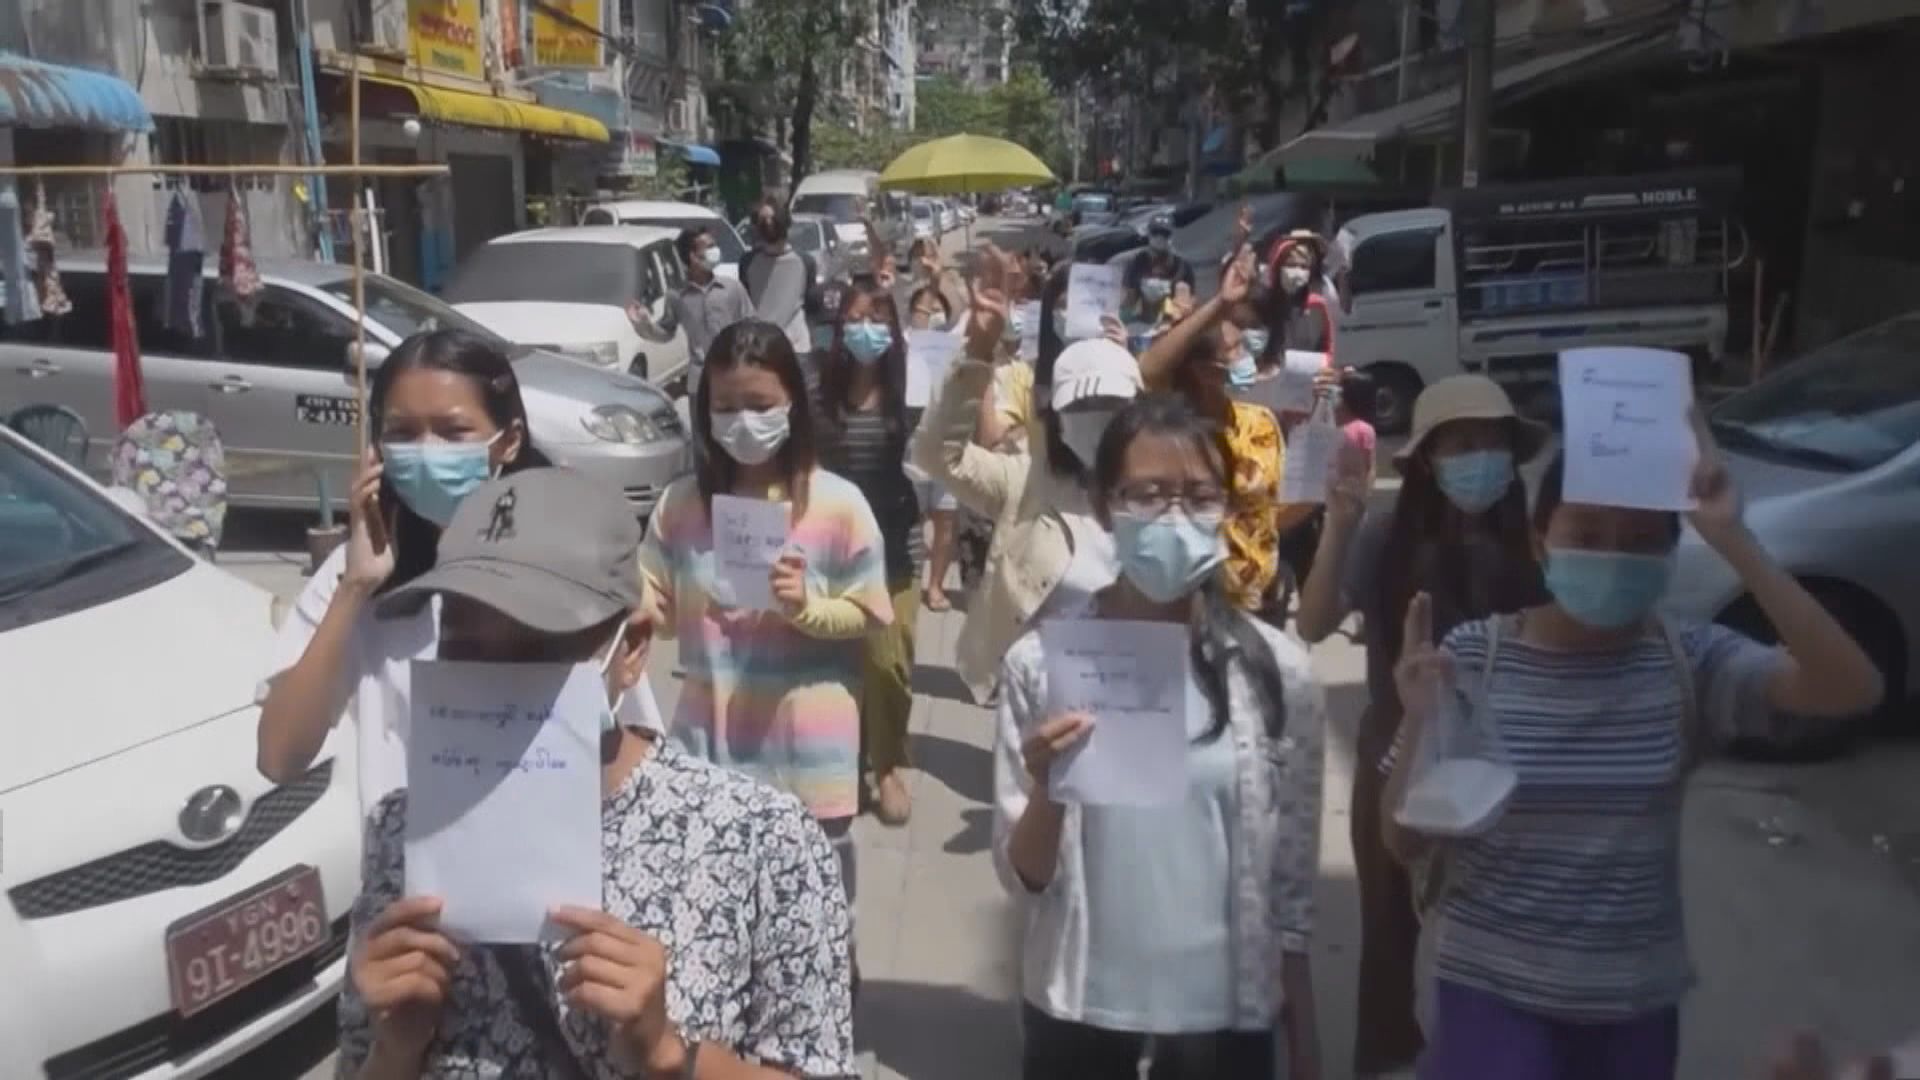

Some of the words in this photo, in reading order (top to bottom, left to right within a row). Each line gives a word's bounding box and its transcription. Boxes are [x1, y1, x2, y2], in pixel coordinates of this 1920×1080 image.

[1642, 187, 1697, 205] NOBLE
[225, 898, 277, 934] YGN
[186, 900, 321, 1001] 9I-4996
